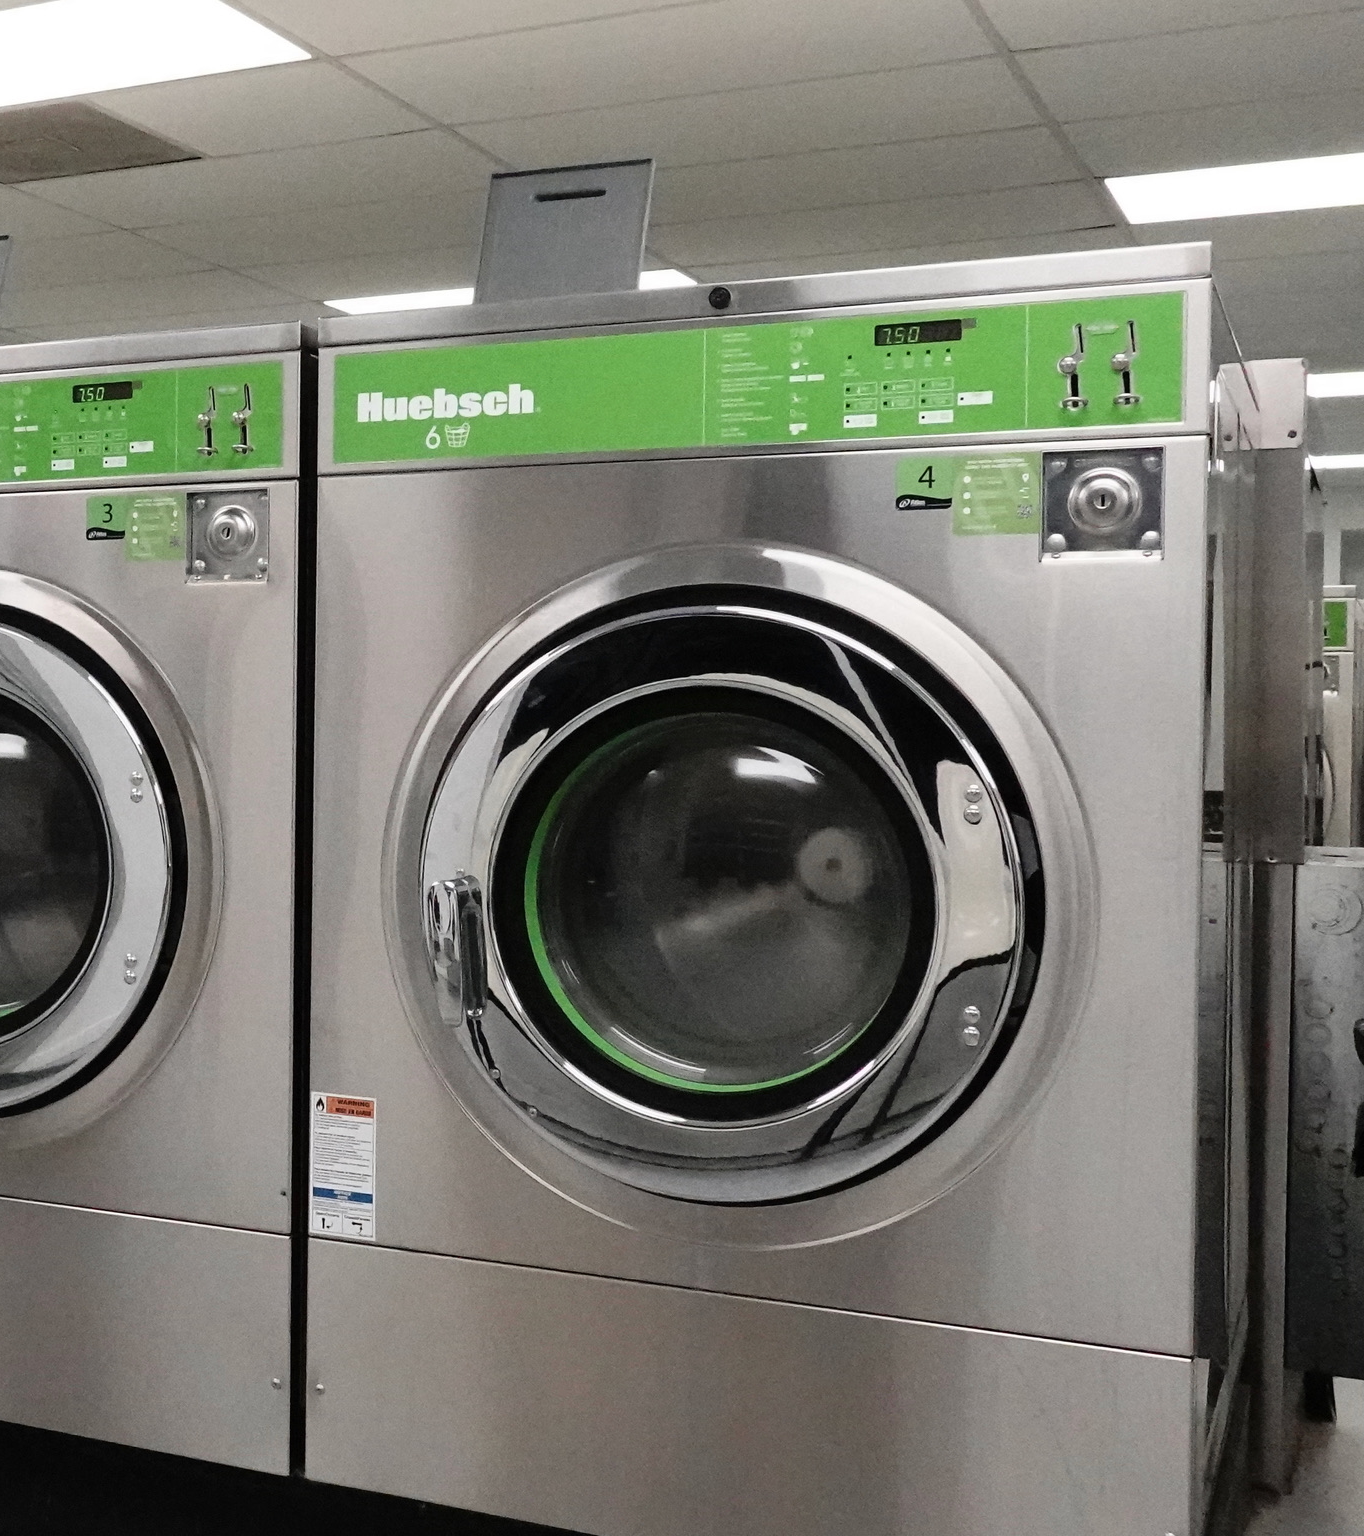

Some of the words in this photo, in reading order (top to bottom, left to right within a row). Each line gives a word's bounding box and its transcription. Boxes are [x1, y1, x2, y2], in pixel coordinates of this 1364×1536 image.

[357, 383, 535, 423] Huebsch
[425, 425, 441, 450] 6
[917, 465, 936, 490] 4
[101, 504, 113, 523] 3
[337, 1099, 371, 1108] WARNING
